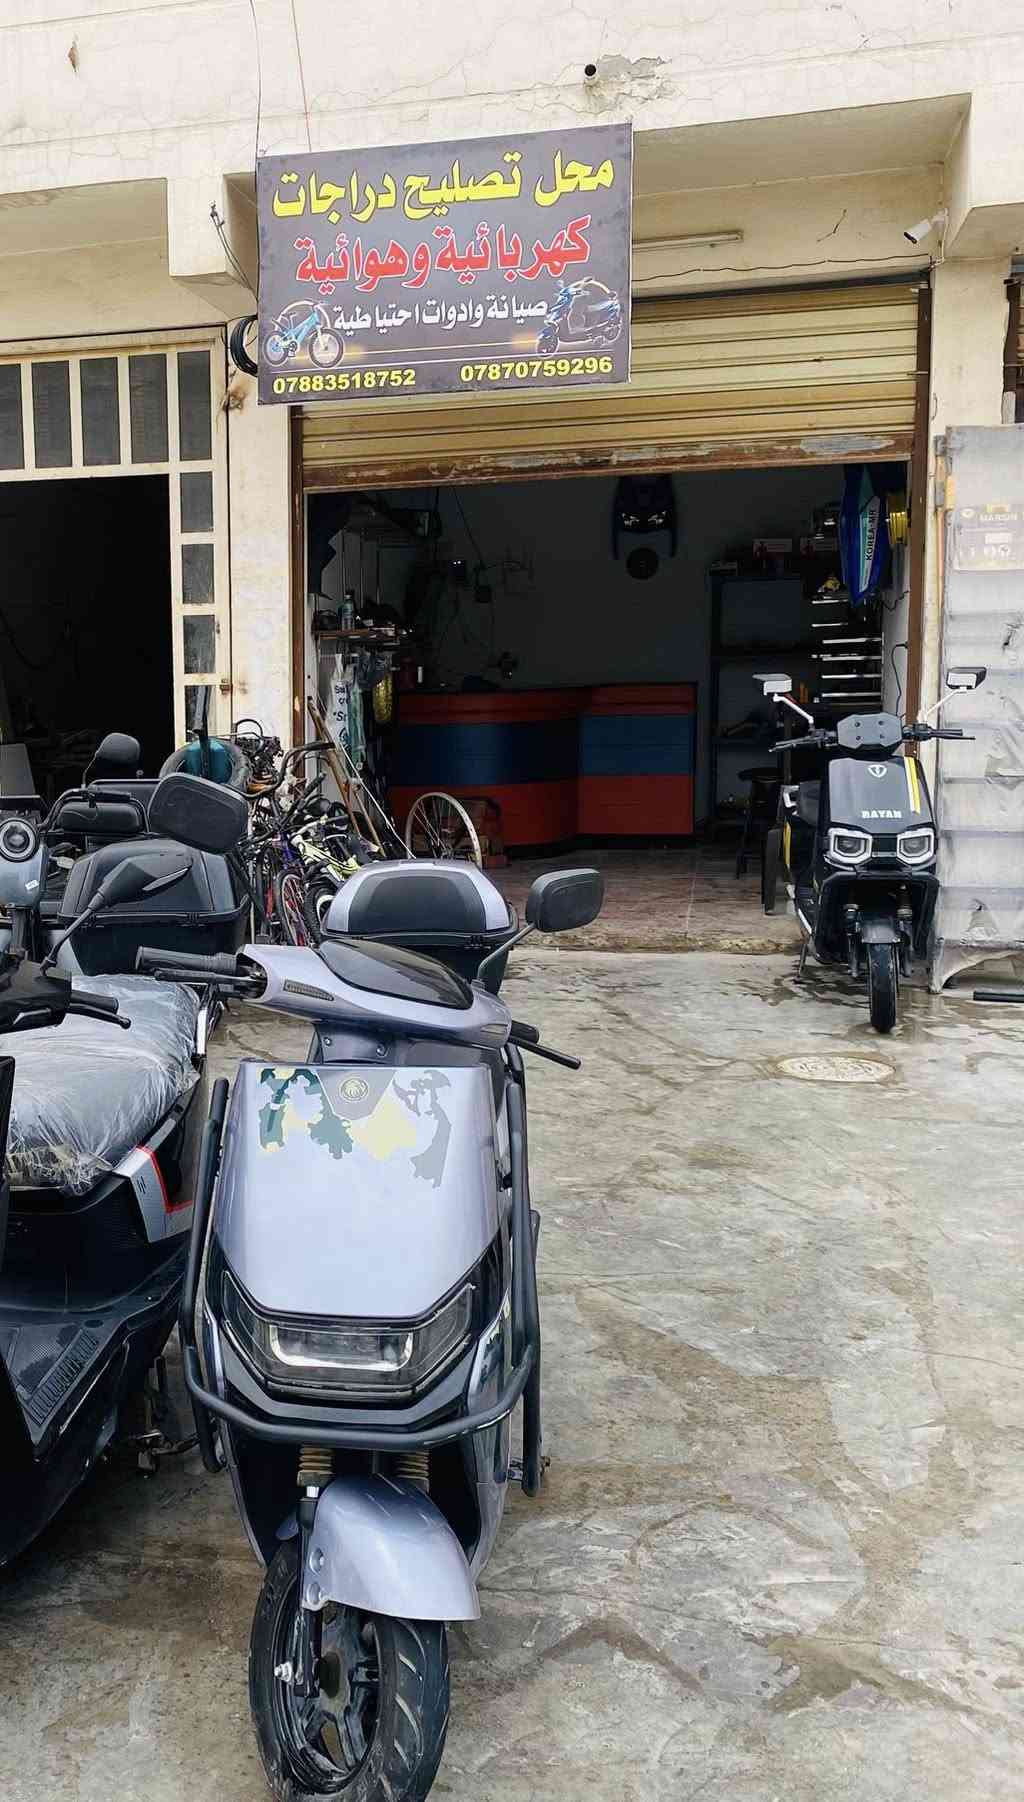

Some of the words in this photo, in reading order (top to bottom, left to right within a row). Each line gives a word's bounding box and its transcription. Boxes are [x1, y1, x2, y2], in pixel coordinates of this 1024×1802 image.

[271, 170, 397, 226] دراجات
[401, 150, 523, 220] تصليح
[534, 149, 616, 207] محل
[294, 233, 432, 296] وهوائية
[433, 214, 593, 284] كهربائية
[333, 303, 418, 336] احتياطية
[422, 298, 484, 329] وادوات
[486, 295, 549, 324] صيانة
[273, 368, 416, 394] 07883518752
[460, 356, 613, 382] 07870759296
